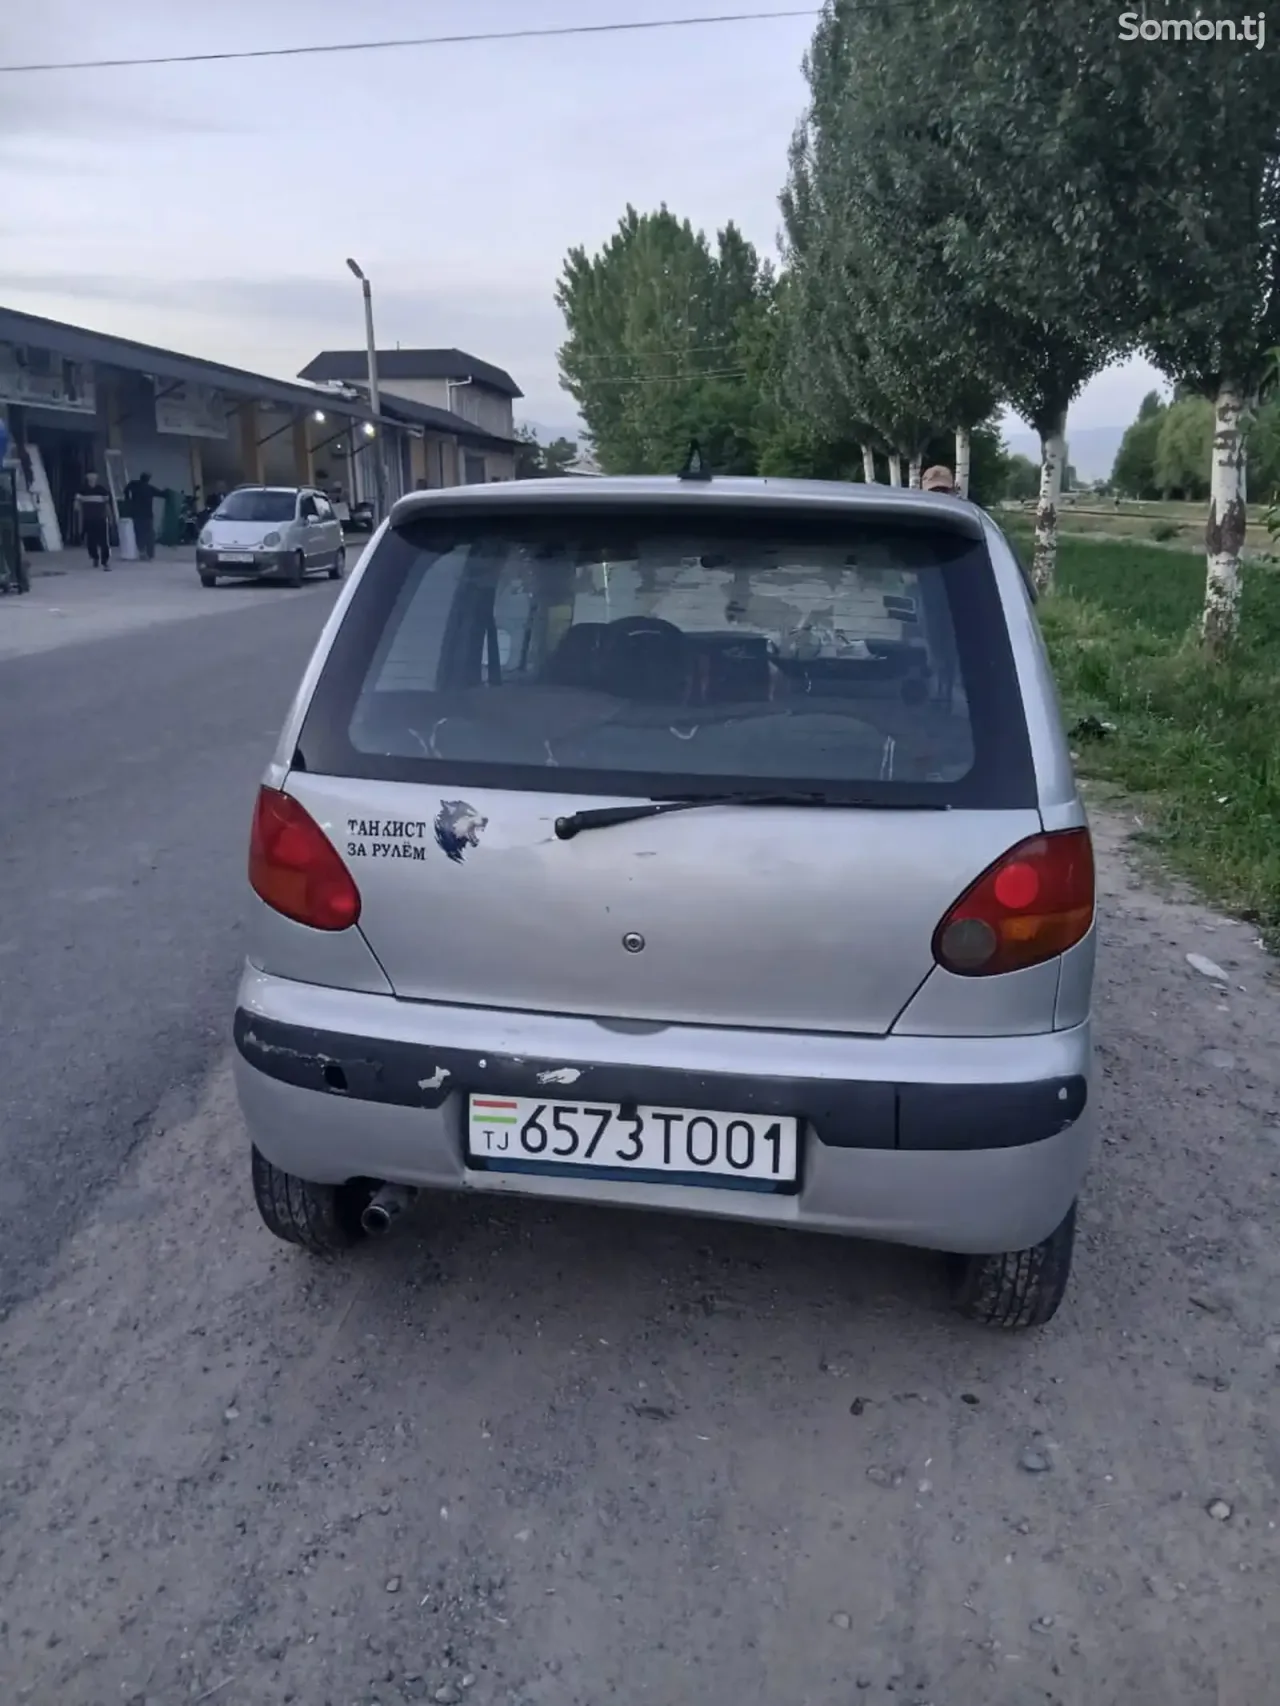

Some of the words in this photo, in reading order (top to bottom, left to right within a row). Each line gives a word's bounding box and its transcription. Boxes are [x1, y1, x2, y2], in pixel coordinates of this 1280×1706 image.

[347, 842, 368, 857] ЗА
[373, 841, 426, 861] РУЛЁМ
[482, 1130, 509, 1151] TJ
